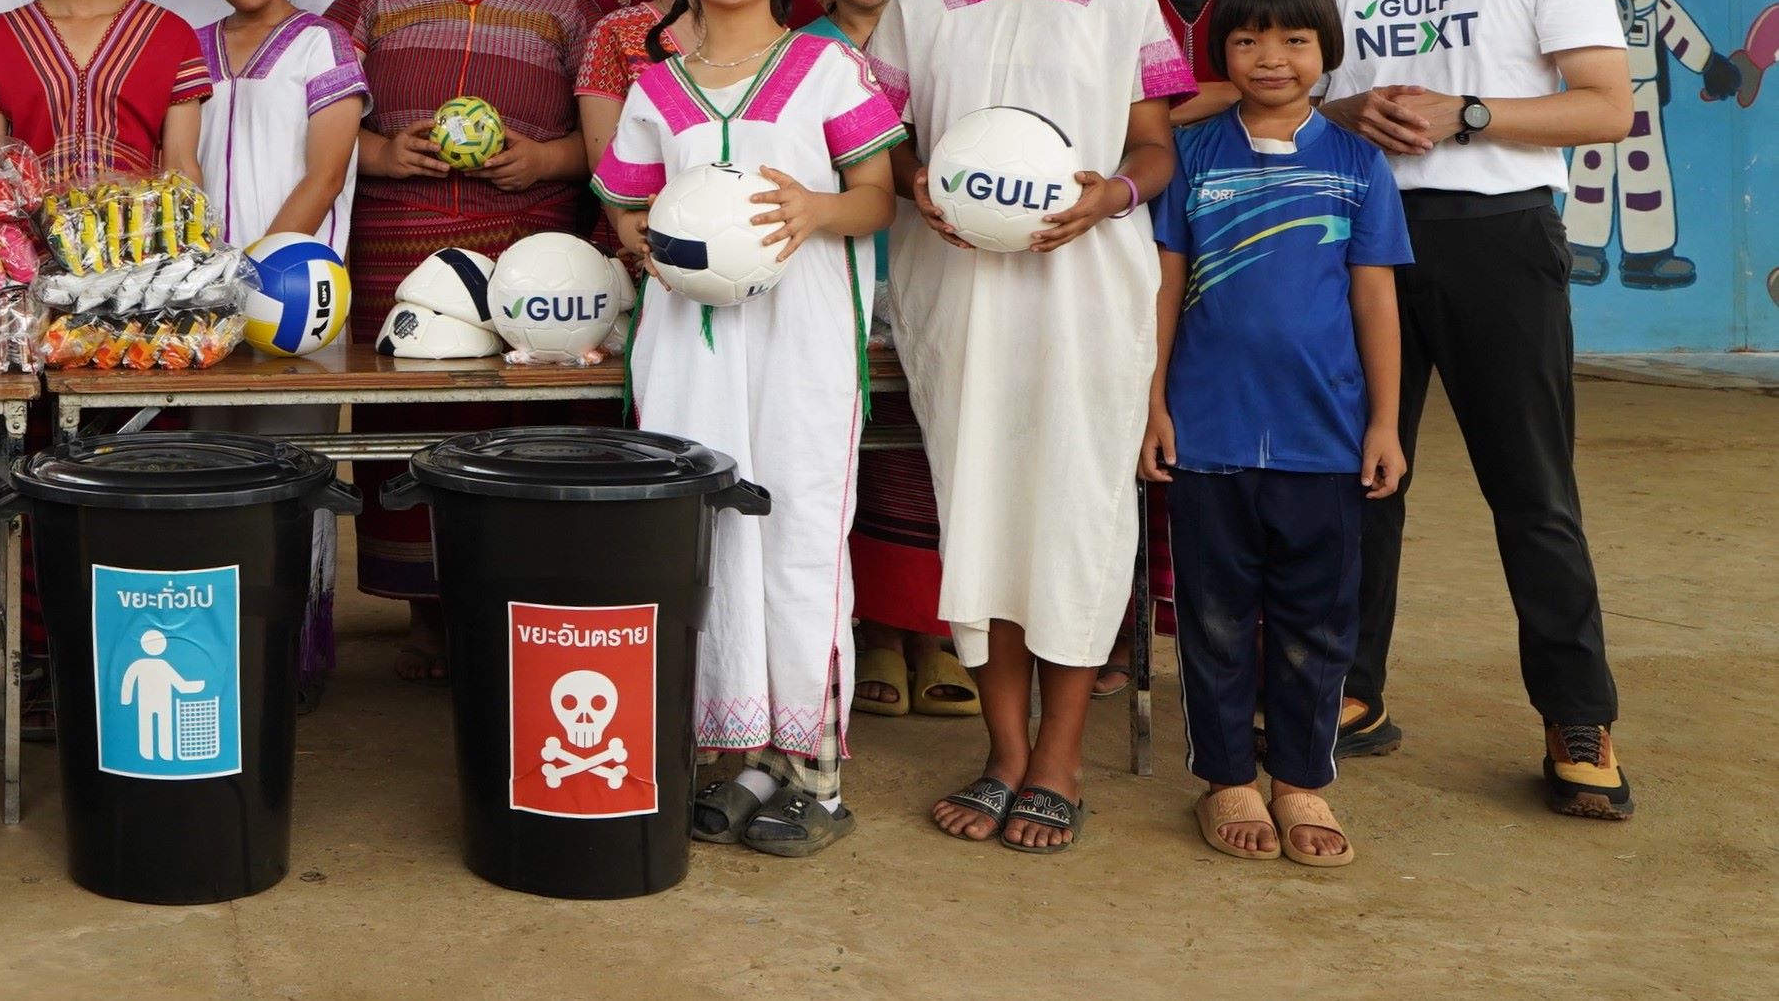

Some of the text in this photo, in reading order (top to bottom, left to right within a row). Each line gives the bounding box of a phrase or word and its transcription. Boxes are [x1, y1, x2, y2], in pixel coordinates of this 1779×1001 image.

[1355, 11, 1479, 61] NEXT
[966, 171, 1063, 211] GULF
[526, 293, 608, 322] GULF
[117, 580, 214, 610] ขยะทั่วไป
[517, 622, 649, 648] ขยะอันตราย
